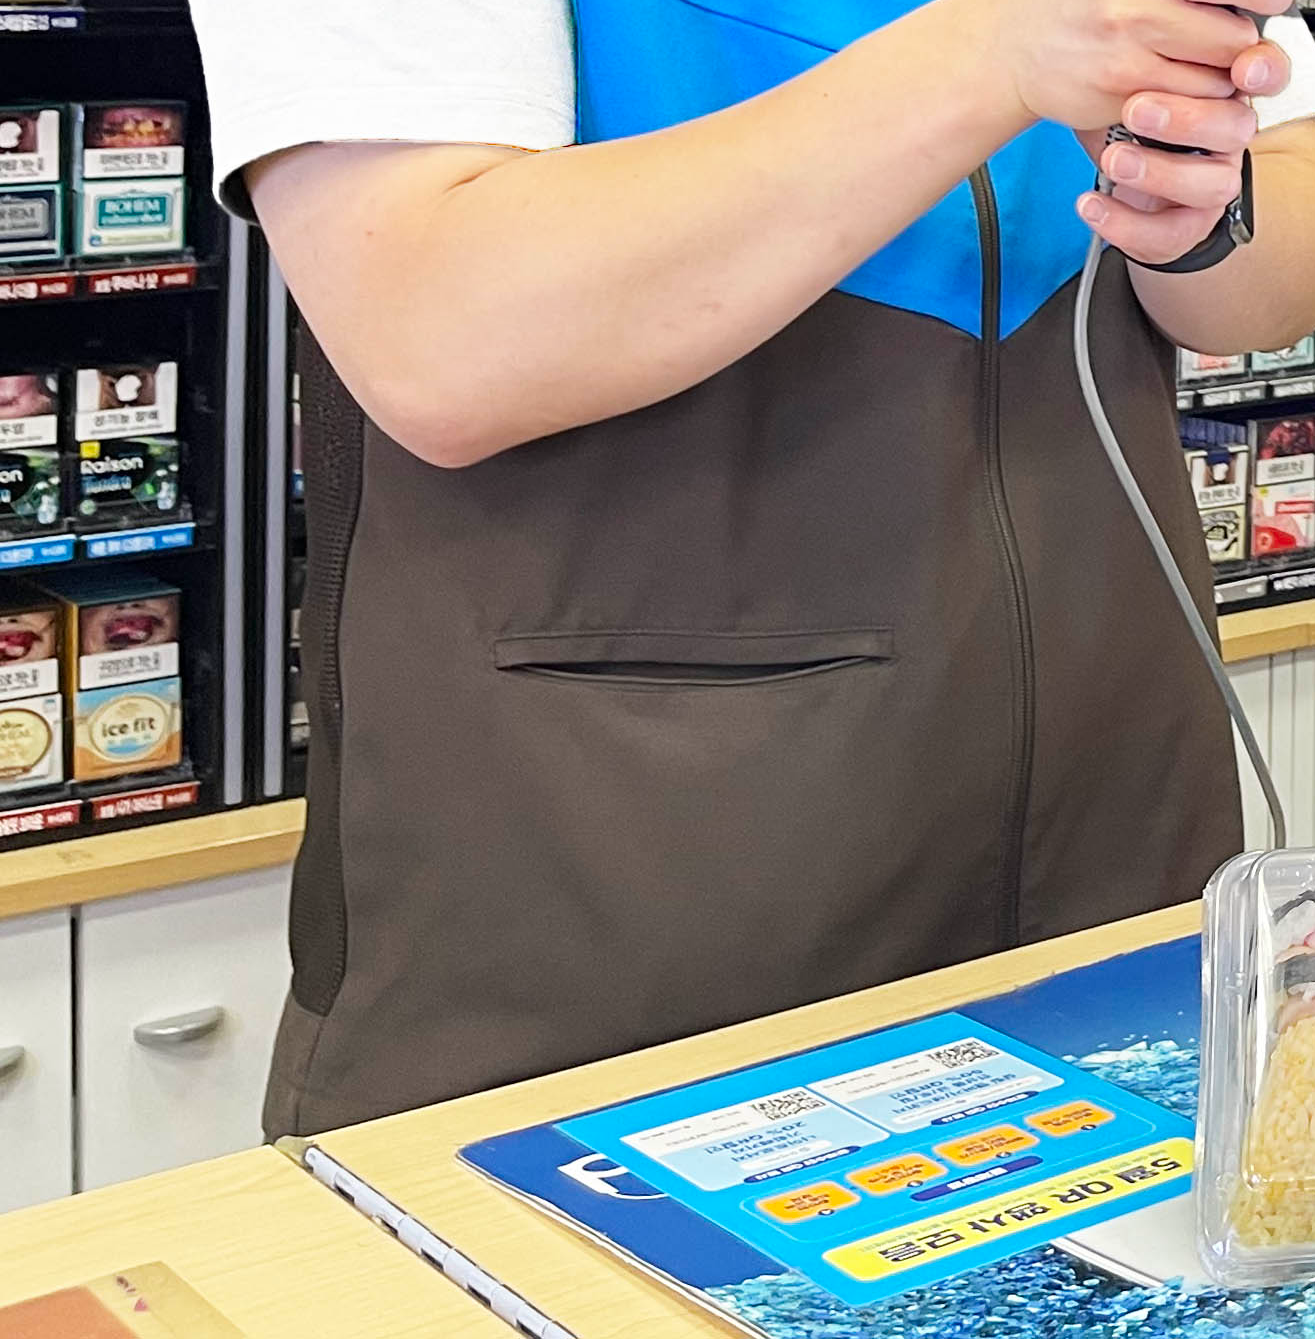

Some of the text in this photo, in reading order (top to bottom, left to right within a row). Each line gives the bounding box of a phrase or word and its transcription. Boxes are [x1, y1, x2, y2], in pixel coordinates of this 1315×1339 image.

[81, 456, 144, 475] Raison
[101, 716, 156, 738] ice fit
[877, 1157, 1182, 1264] 5월 QR 행사 모음
